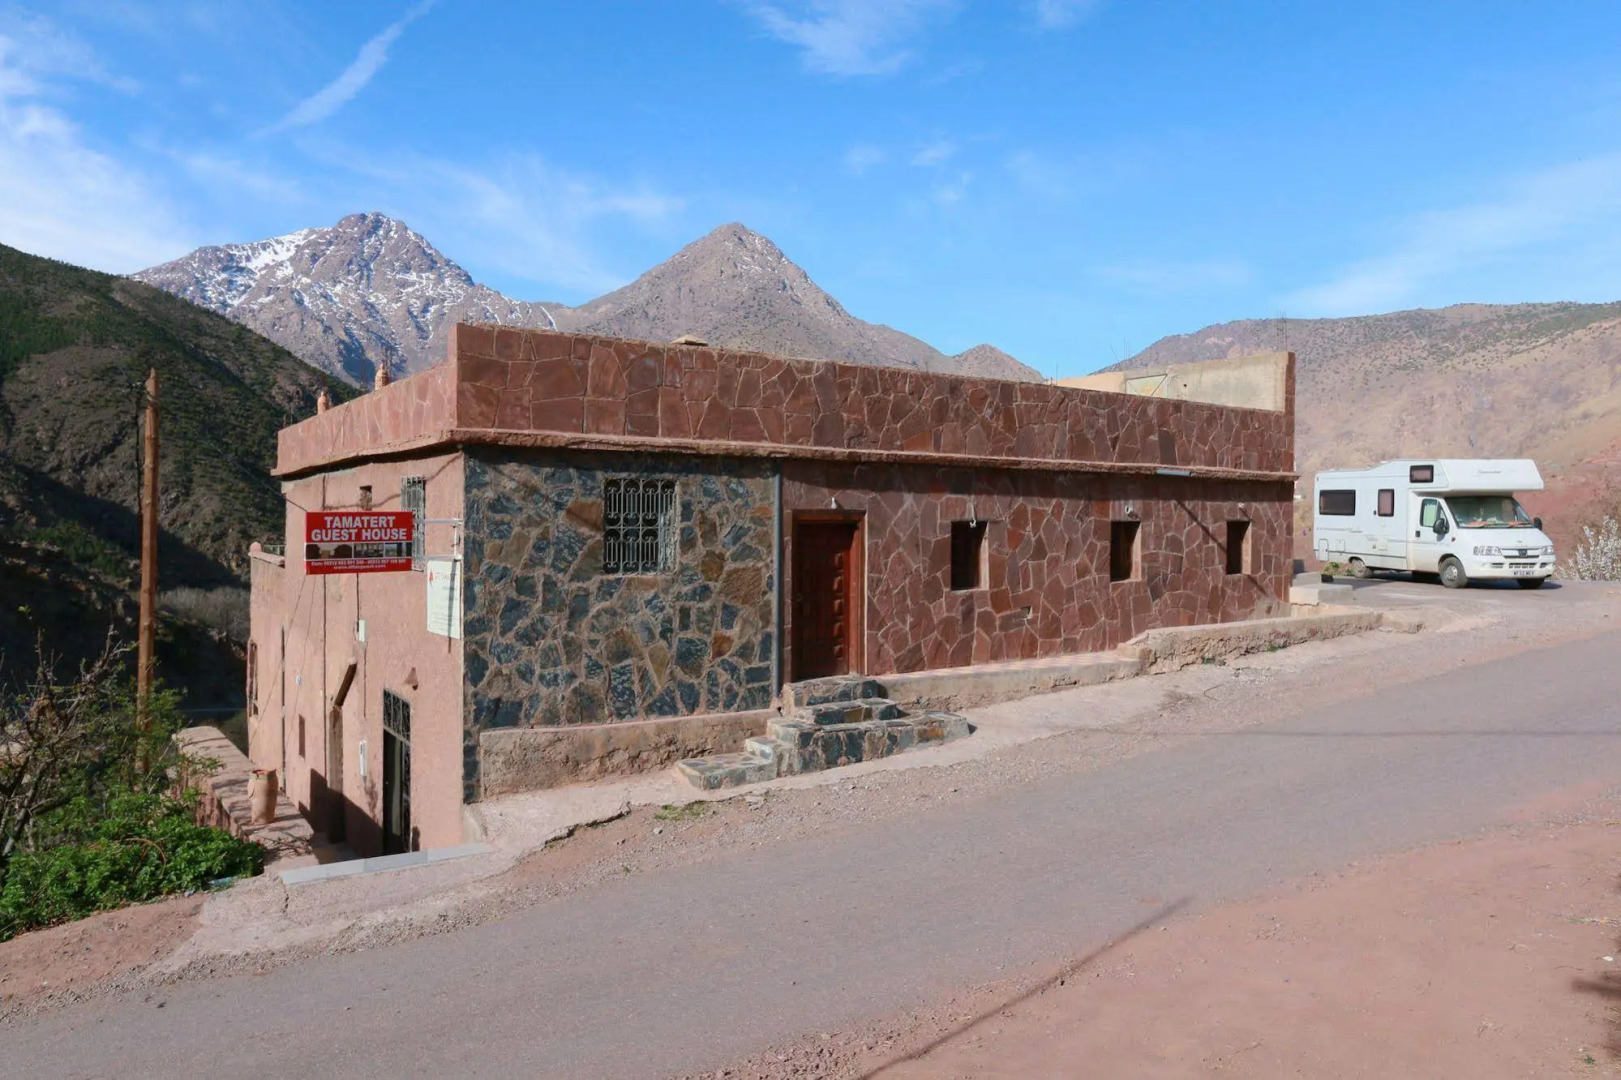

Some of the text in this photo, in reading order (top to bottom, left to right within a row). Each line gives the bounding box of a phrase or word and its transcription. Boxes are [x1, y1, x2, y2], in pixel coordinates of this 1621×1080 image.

[324, 516, 396, 528] TAMATERT
[311, 528, 407, 541] GUEST HOUSE
